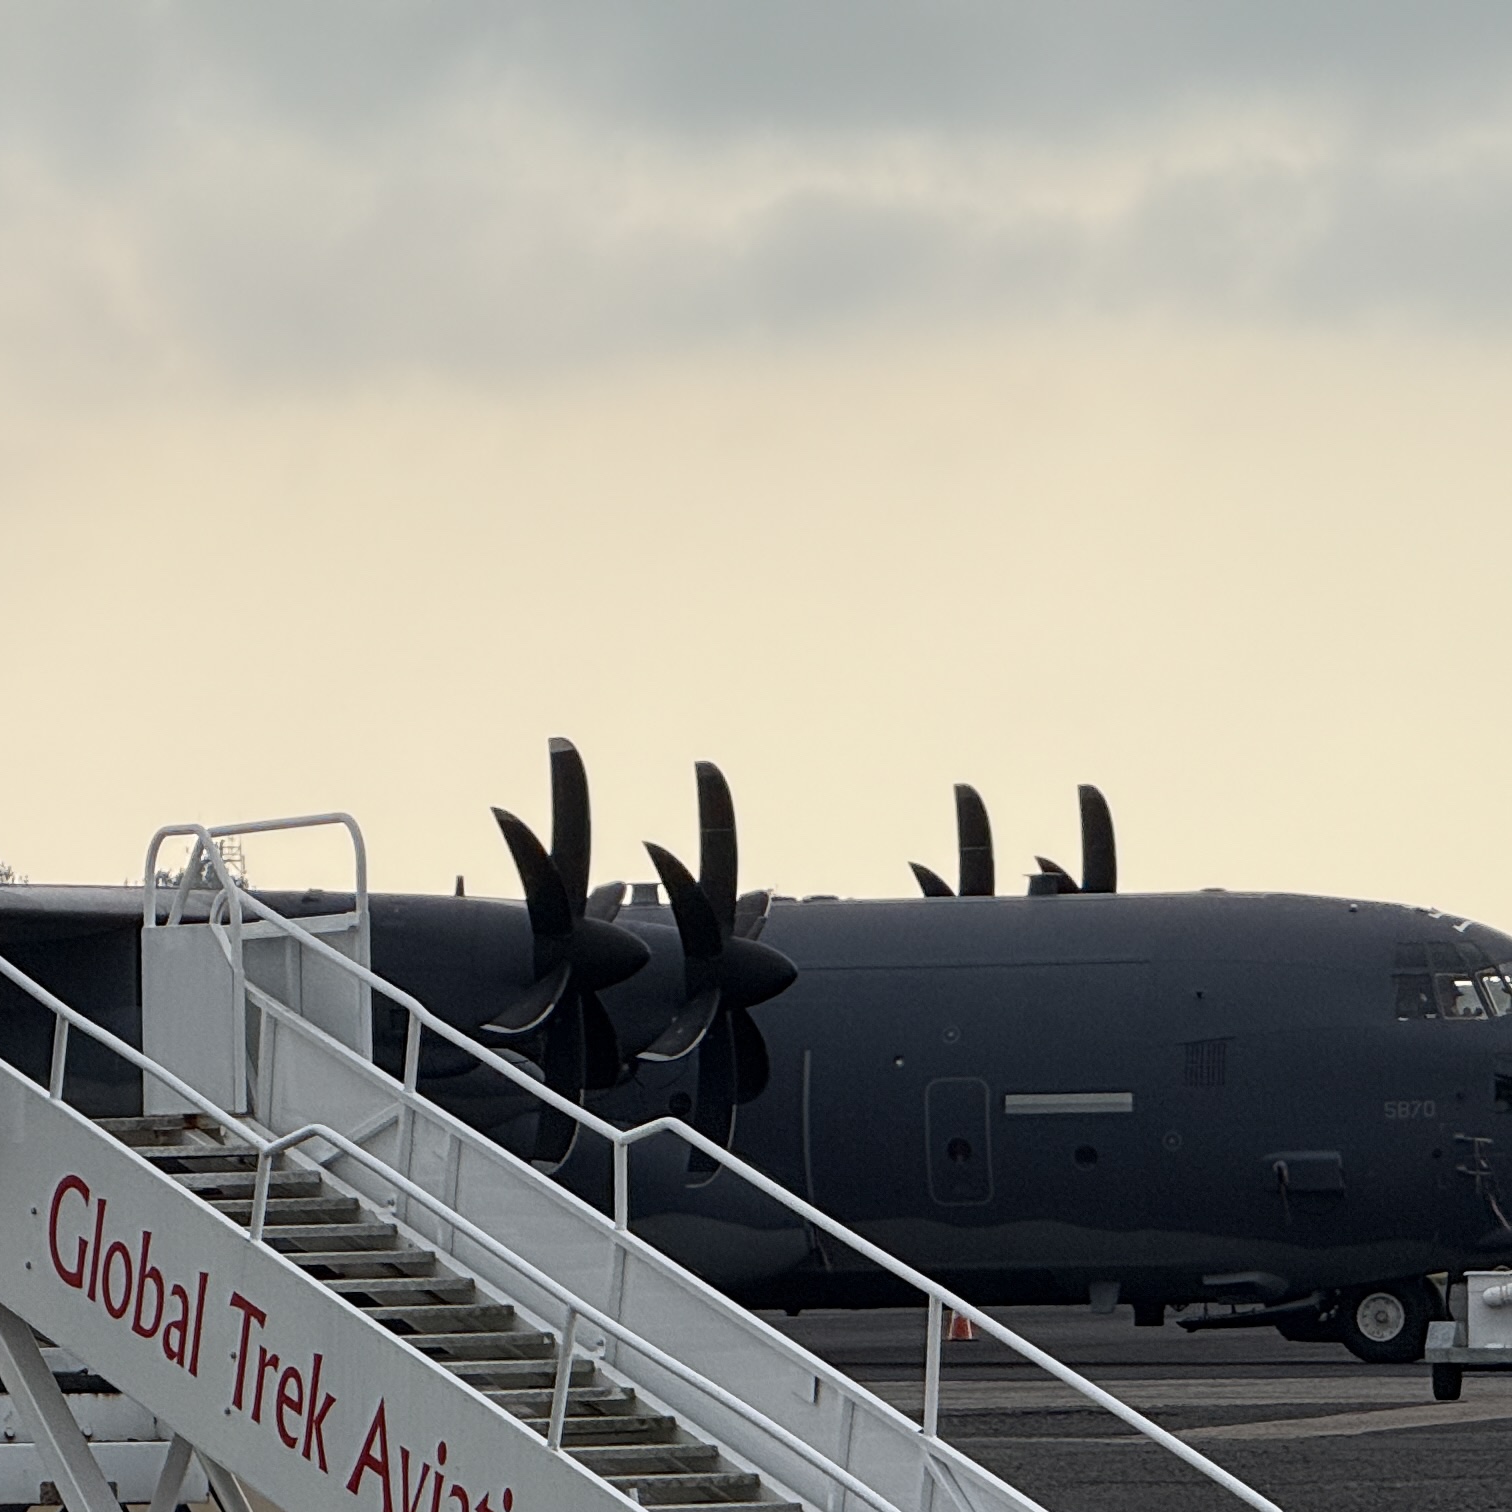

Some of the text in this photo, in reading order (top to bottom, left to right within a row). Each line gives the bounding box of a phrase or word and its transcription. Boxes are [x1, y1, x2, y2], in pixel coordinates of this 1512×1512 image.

[1383, 1100, 1436, 1119] 5870
[48, 1174, 209, 1378] Global
[229, 1291, 337, 1475] Trek
